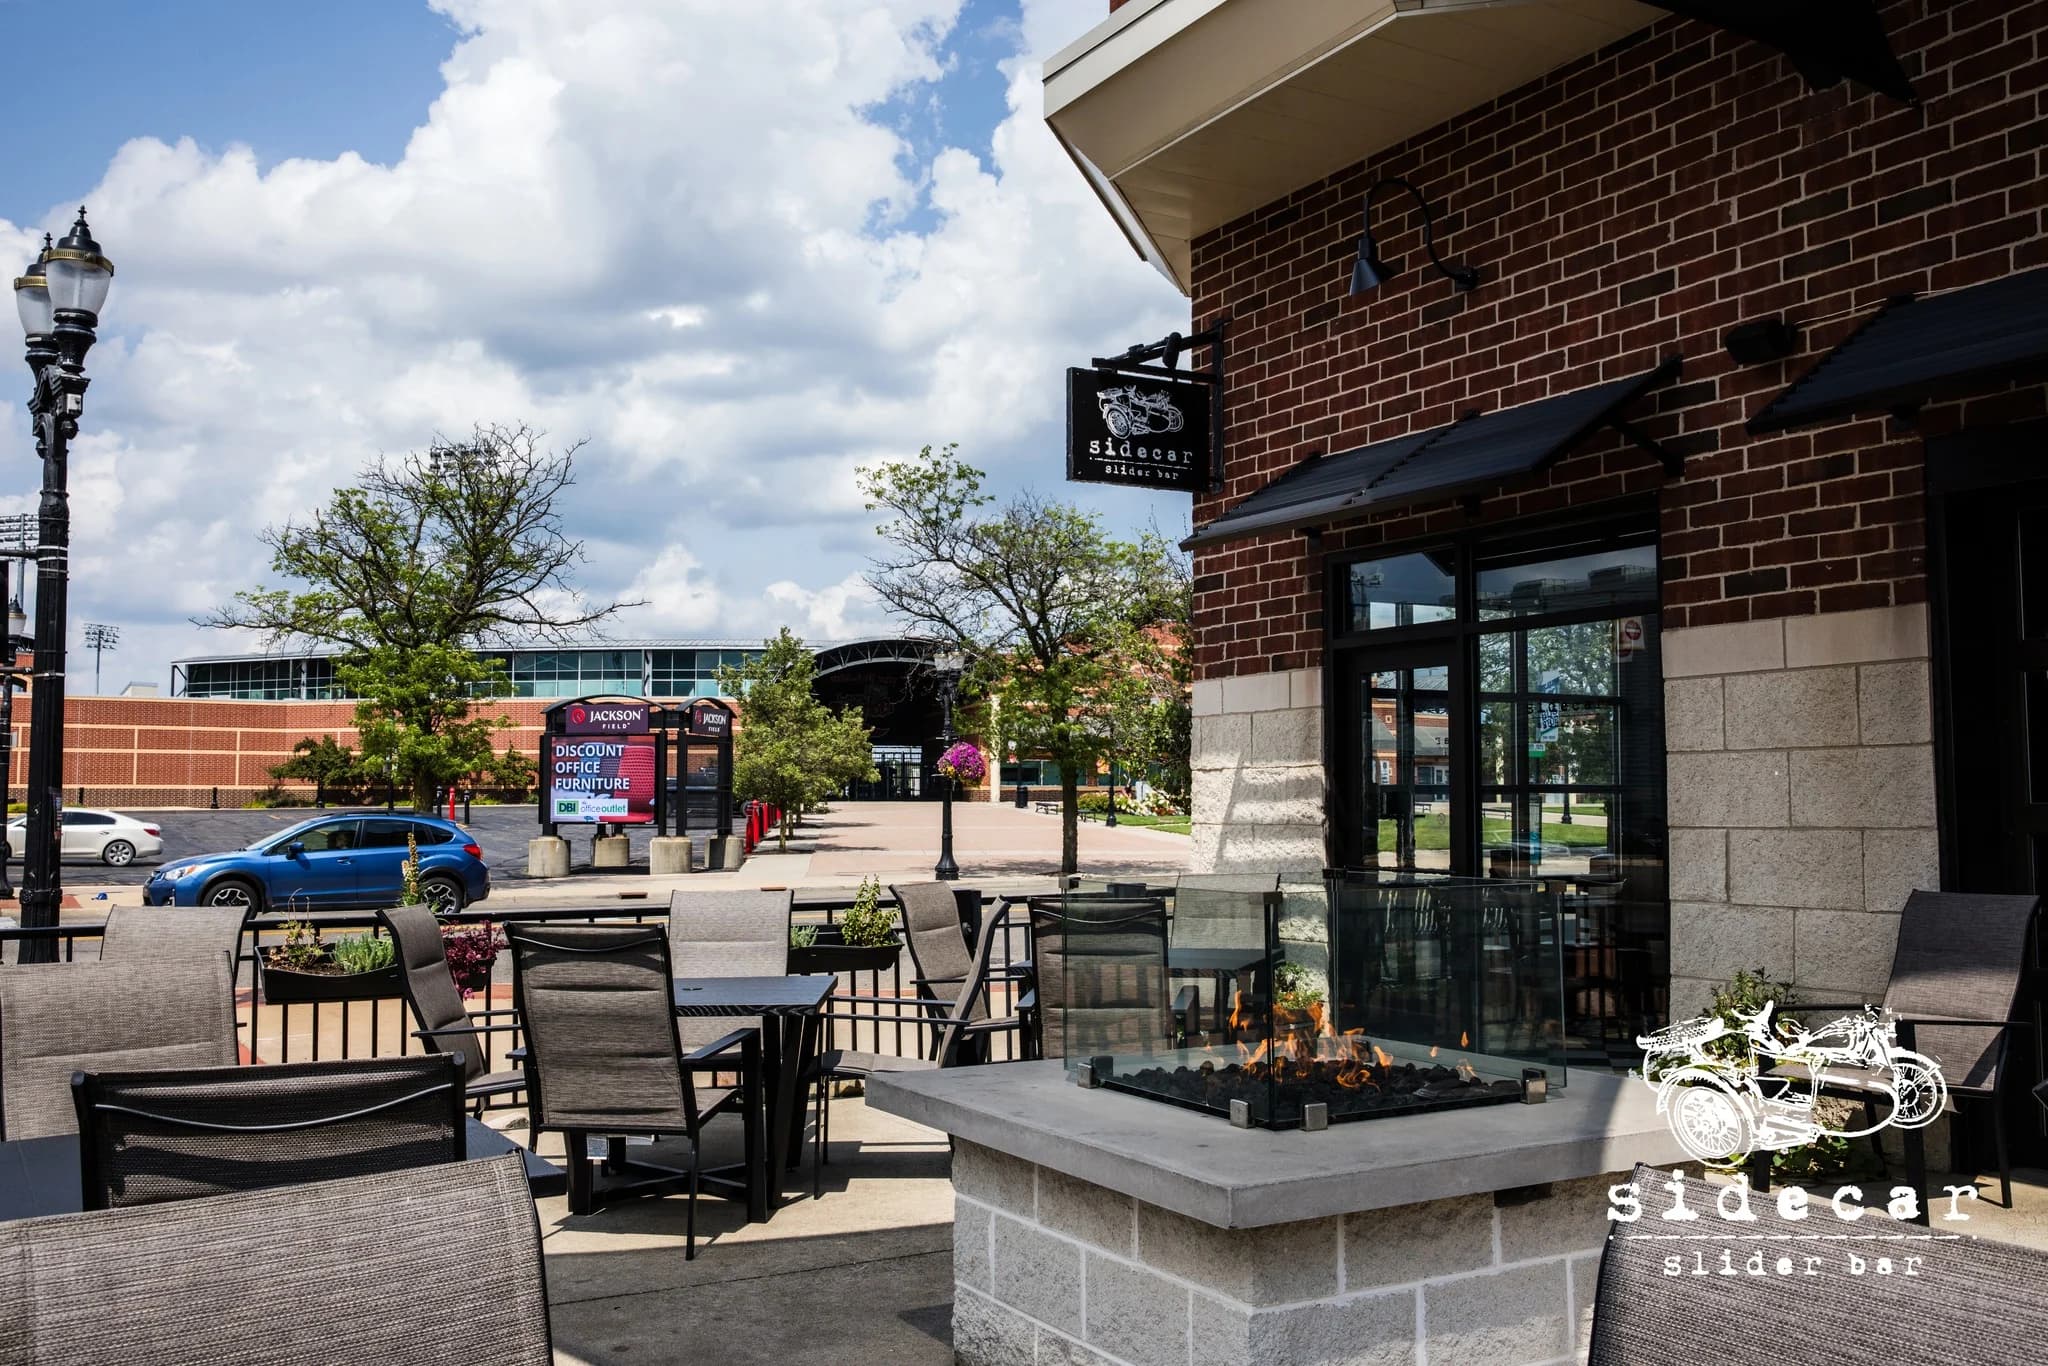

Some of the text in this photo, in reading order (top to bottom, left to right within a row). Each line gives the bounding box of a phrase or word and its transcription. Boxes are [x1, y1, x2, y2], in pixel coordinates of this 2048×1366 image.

[1089, 437, 1193, 463] sidecar
[1105, 464, 1179, 480] slider bar
[589, 709, 641, 723] JACKSON
[555, 744, 624, 757] DISCOUNT
[555, 761, 600, 774] OFFICE
[555, 777, 630, 790] FURNITURE
[558, 802, 576, 813] DBI
[580, 804, 626, 813] office outlet
